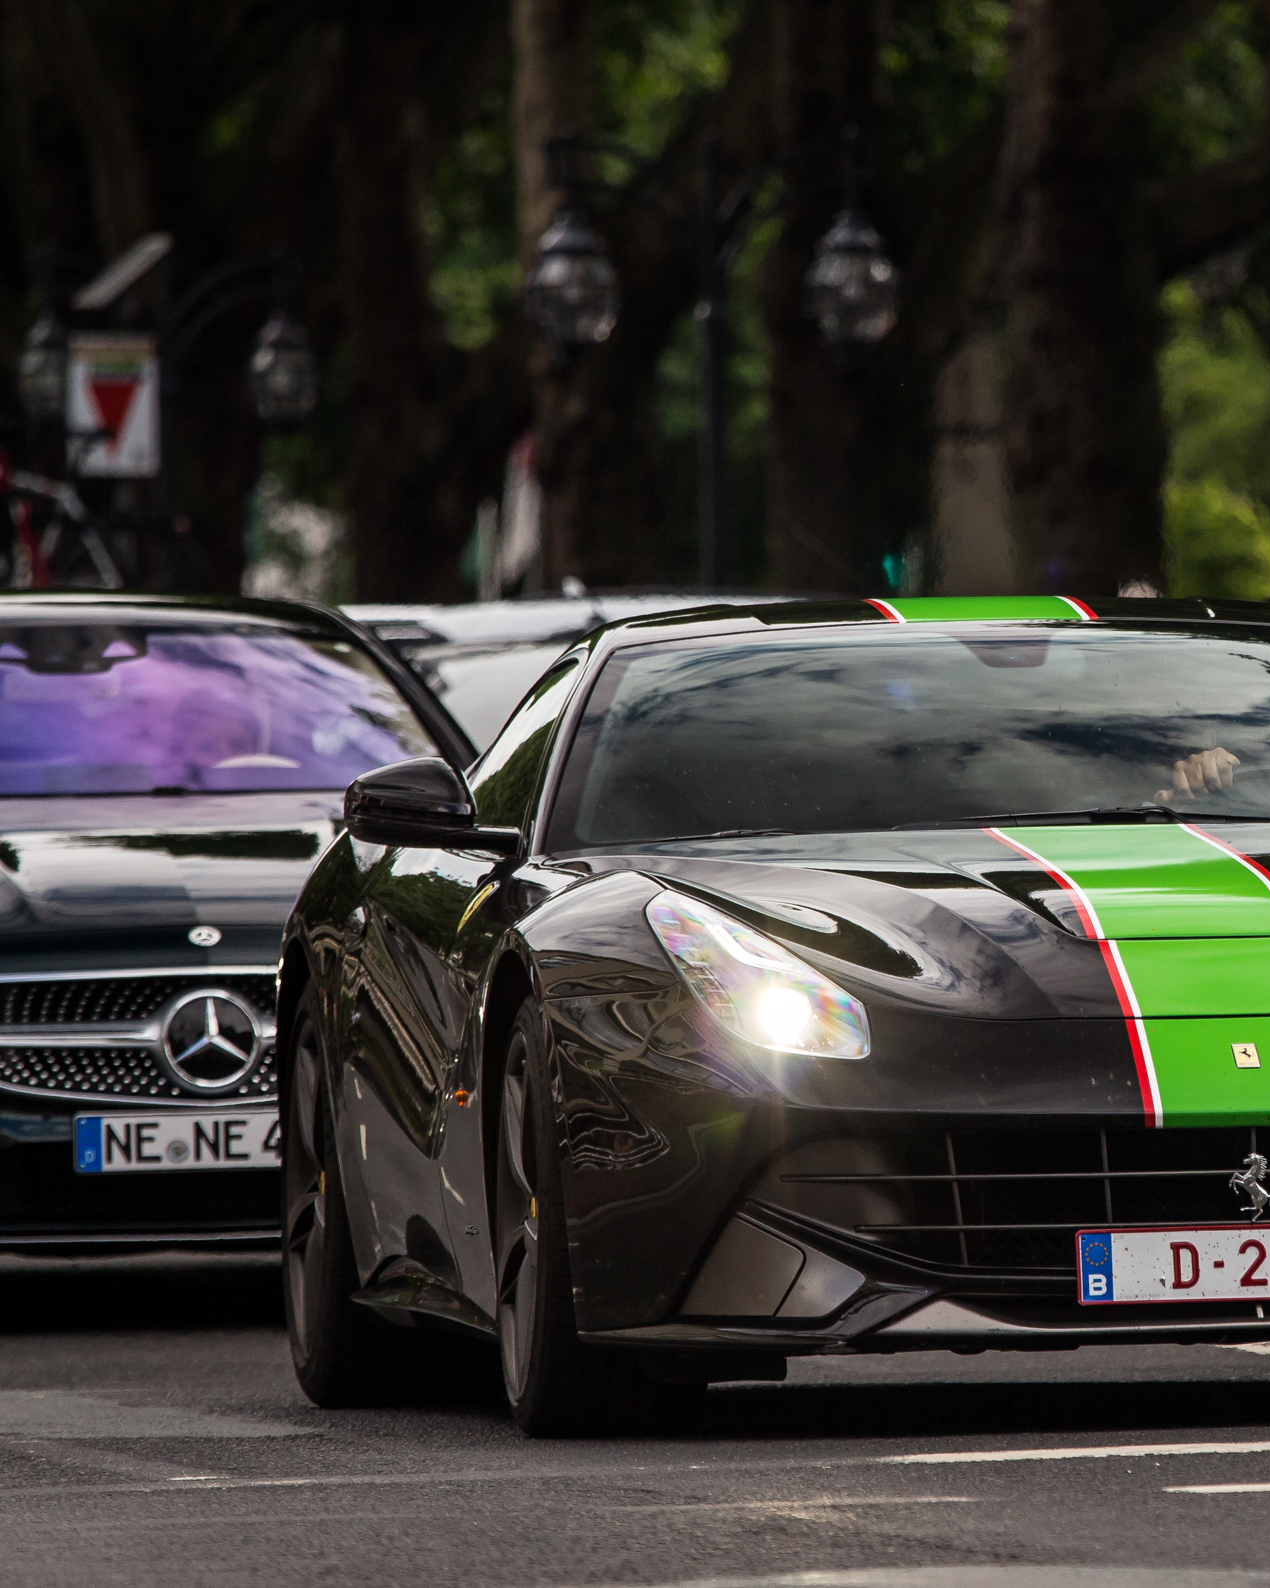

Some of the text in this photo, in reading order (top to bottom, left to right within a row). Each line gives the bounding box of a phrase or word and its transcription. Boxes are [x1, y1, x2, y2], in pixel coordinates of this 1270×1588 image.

[105, 1122, 162, 1164] NE
[193, 1119, 250, 1162] NE
[1088, 1274, 1107, 1296] B
